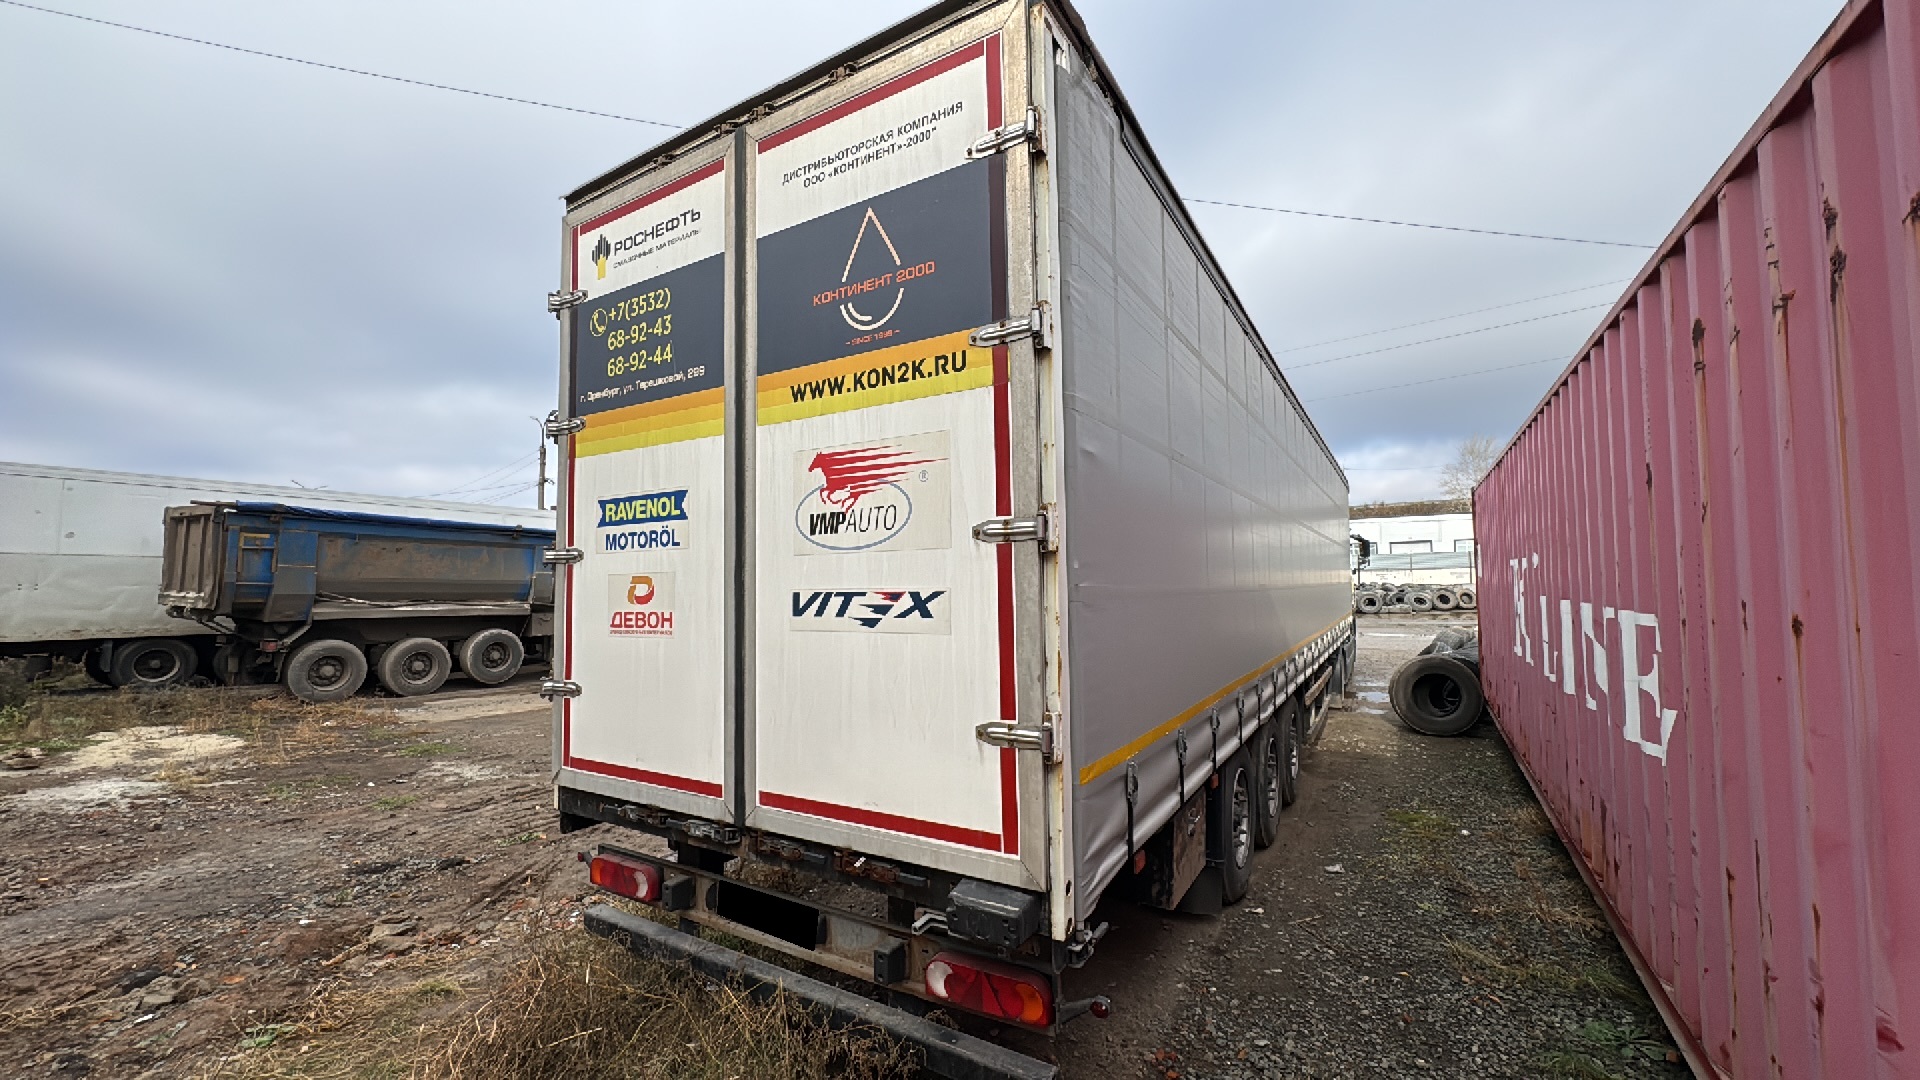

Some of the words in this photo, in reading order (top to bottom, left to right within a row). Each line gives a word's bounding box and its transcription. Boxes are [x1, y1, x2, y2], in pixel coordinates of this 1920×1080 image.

[782, 130, 894, 186] ДИСТРИБЬЮТОРСКАЯ
[897, 101, 963, 137] КОМПАНИЯ
[803, 171, 826, 188] ООО
[614, 208, 701, 256] РОСНЕФТЬ
[813, 273, 893, 306] КОНТИНЕНТ
[896, 261, 936, 283] 2000
[608, 287, 671, 322] +7(3532)
[607, 314, 672, 350] 68-92-43
[607, 343, 672, 377] 68-92-44
[790, 350, 967, 403] WWW.KON2K.RU
[587, 387, 622, 402] Оренбург,
[605, 495, 681, 523] RAVENOL
[605, 525, 681, 551] MOTORÖL
[609, 611, 673, 628] ДЕВОН
